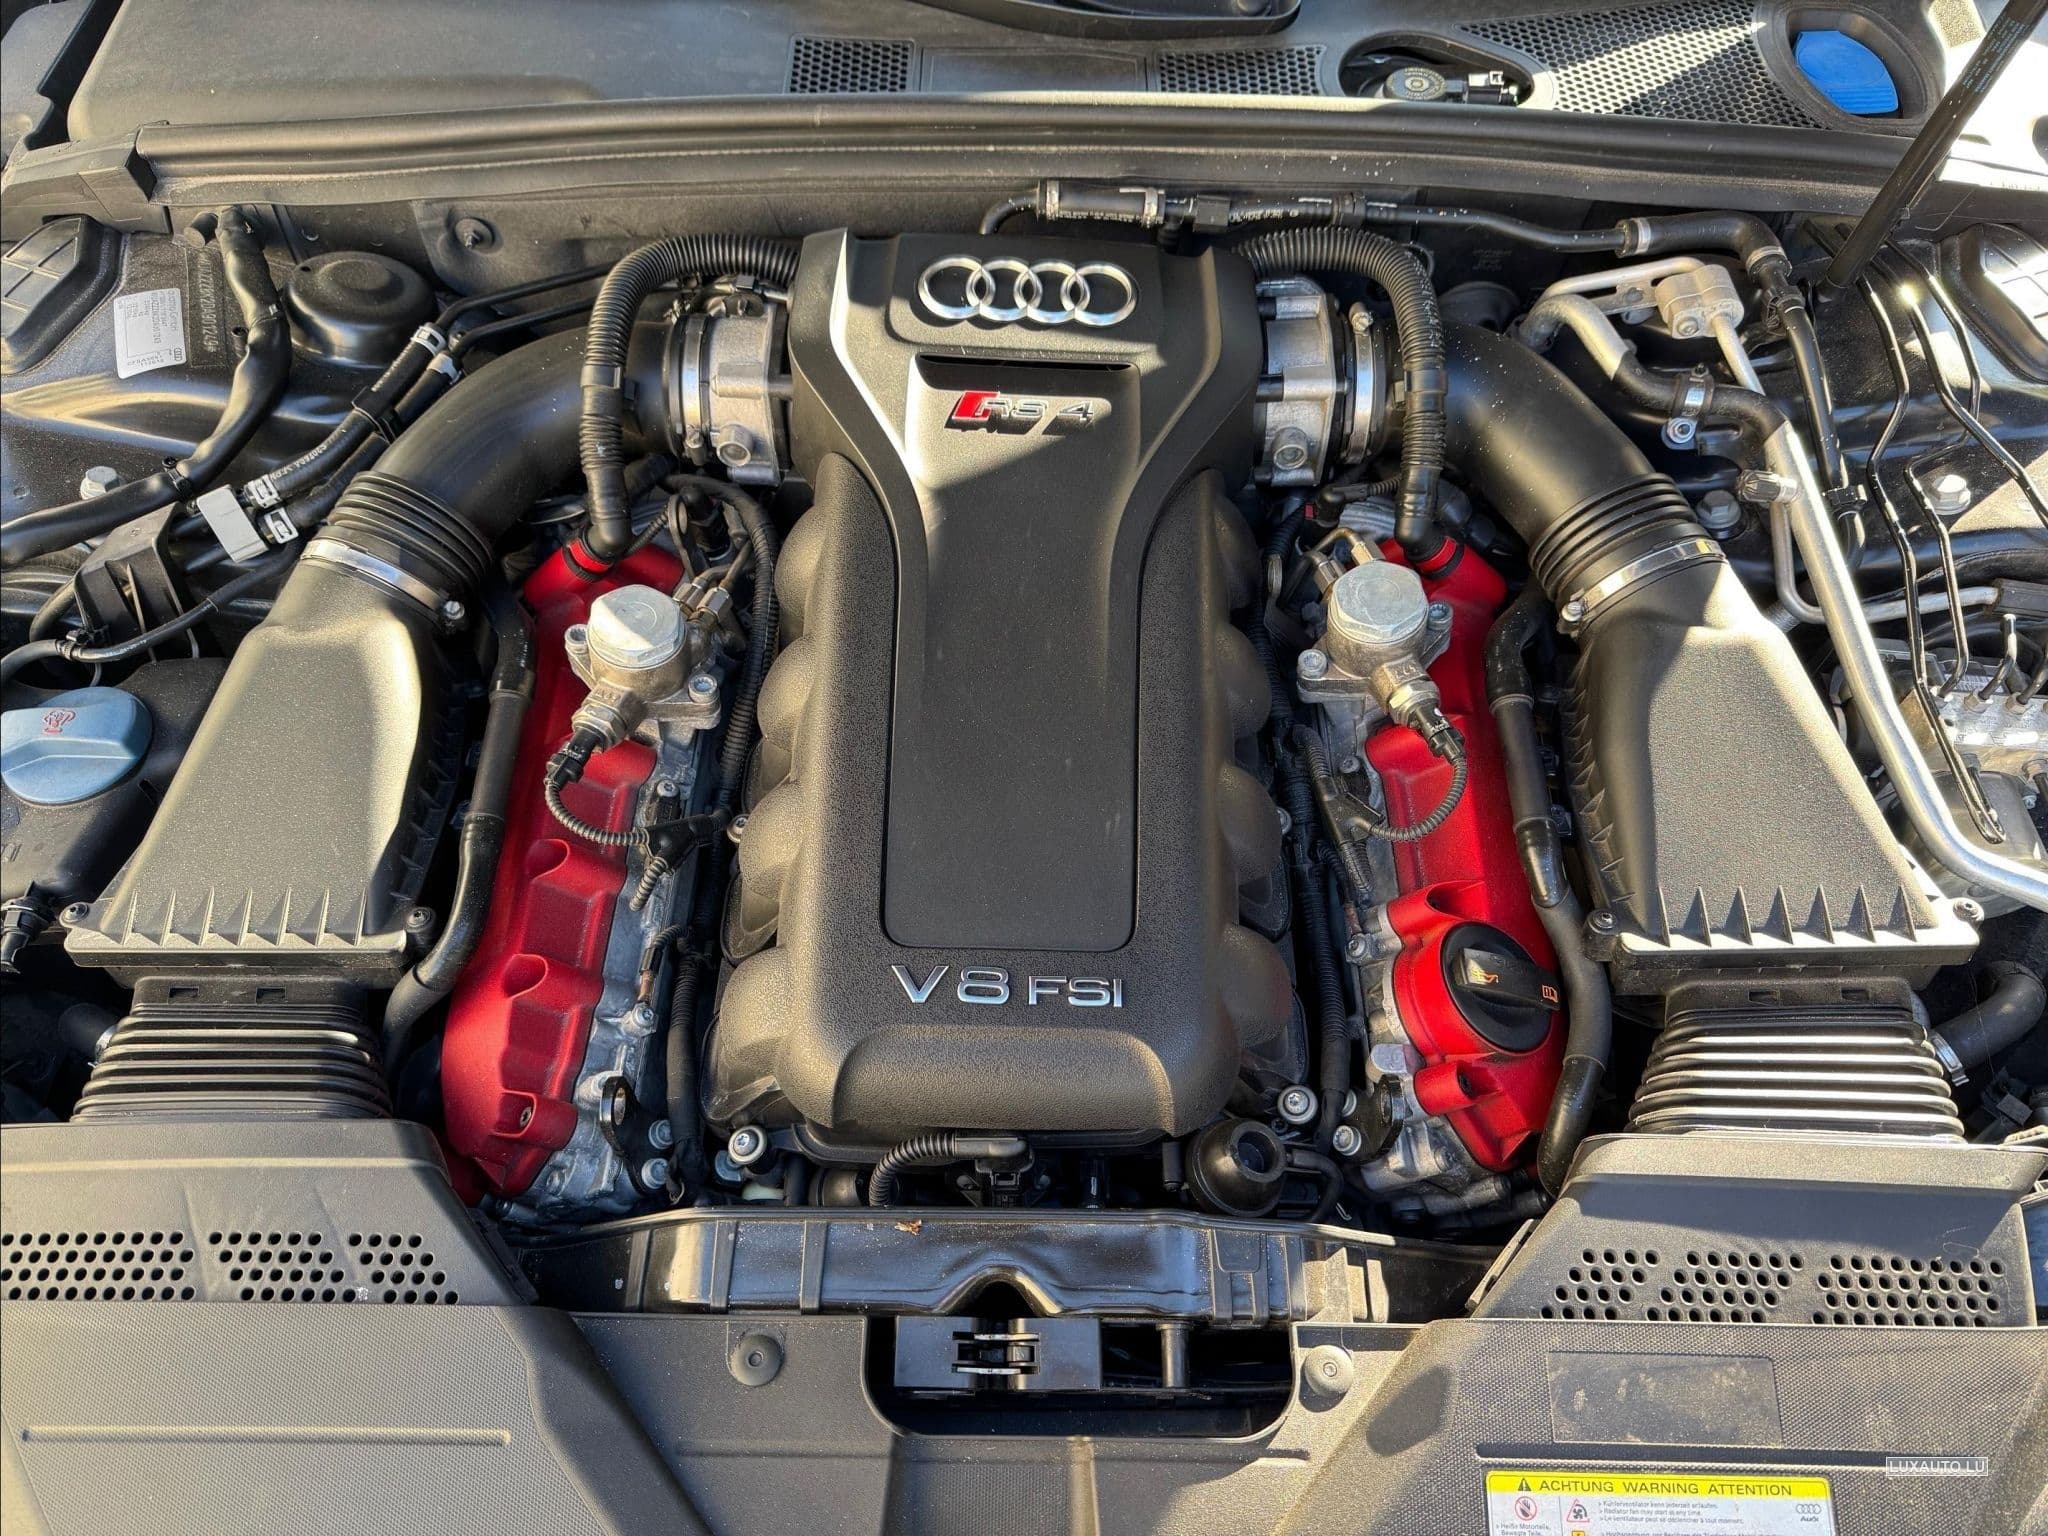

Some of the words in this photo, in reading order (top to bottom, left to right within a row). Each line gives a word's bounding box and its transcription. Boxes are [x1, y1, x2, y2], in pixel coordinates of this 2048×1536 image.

[962, 395, 1048, 419] RS
[1057, 401, 1094, 421] 4
[1028, 975, 1123, 1008] FSI
[1539, 1479, 1614, 1492] ACHTUNG
[1622, 1481, 1699, 1494] WARNING
[1708, 1483, 1792, 1496] ATTENTION
